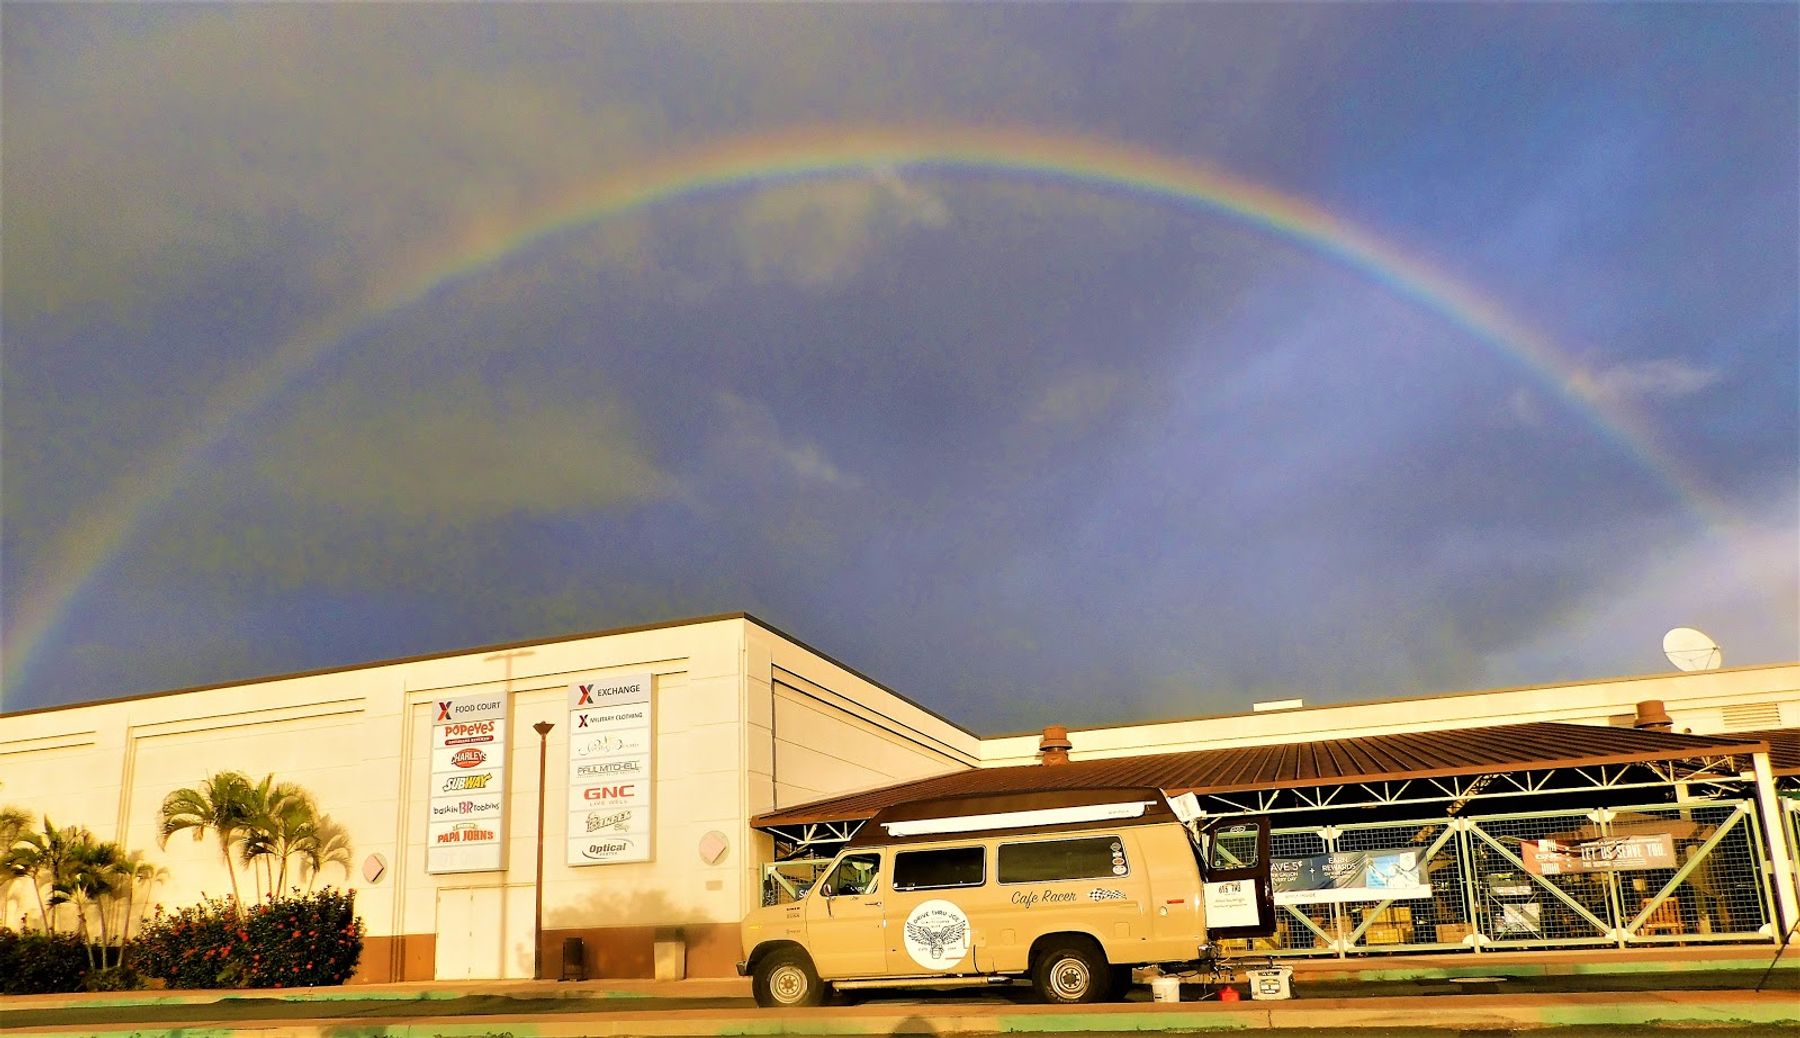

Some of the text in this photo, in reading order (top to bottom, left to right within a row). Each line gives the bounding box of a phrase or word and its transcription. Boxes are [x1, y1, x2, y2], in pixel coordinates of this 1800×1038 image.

[597, 684, 641, 697] EXCHANGE
[455, 704, 475, 713] FOOD
[477, 702, 501, 711] COURT
[615, 712, 643, 721] CLOTHING
[450, 750, 487, 765] CHARLEYS
[442, 772, 493, 792] SUBWAY
[583, 784, 635, 799] GNC
[459, 801, 473, 815] BR
[437, 831, 460, 843] PAPA
[589, 843, 627, 854] Optical
[1581, 847, 1596, 861] LET
[1616, 844, 1642, 858] SERVE
[1271, 862, 1290, 872] AVE
[1322, 863, 1356, 872] REWARDS
[1011, 890, 1077, 909] Cafe Racer
[913, 911, 930, 924] DRIVE
